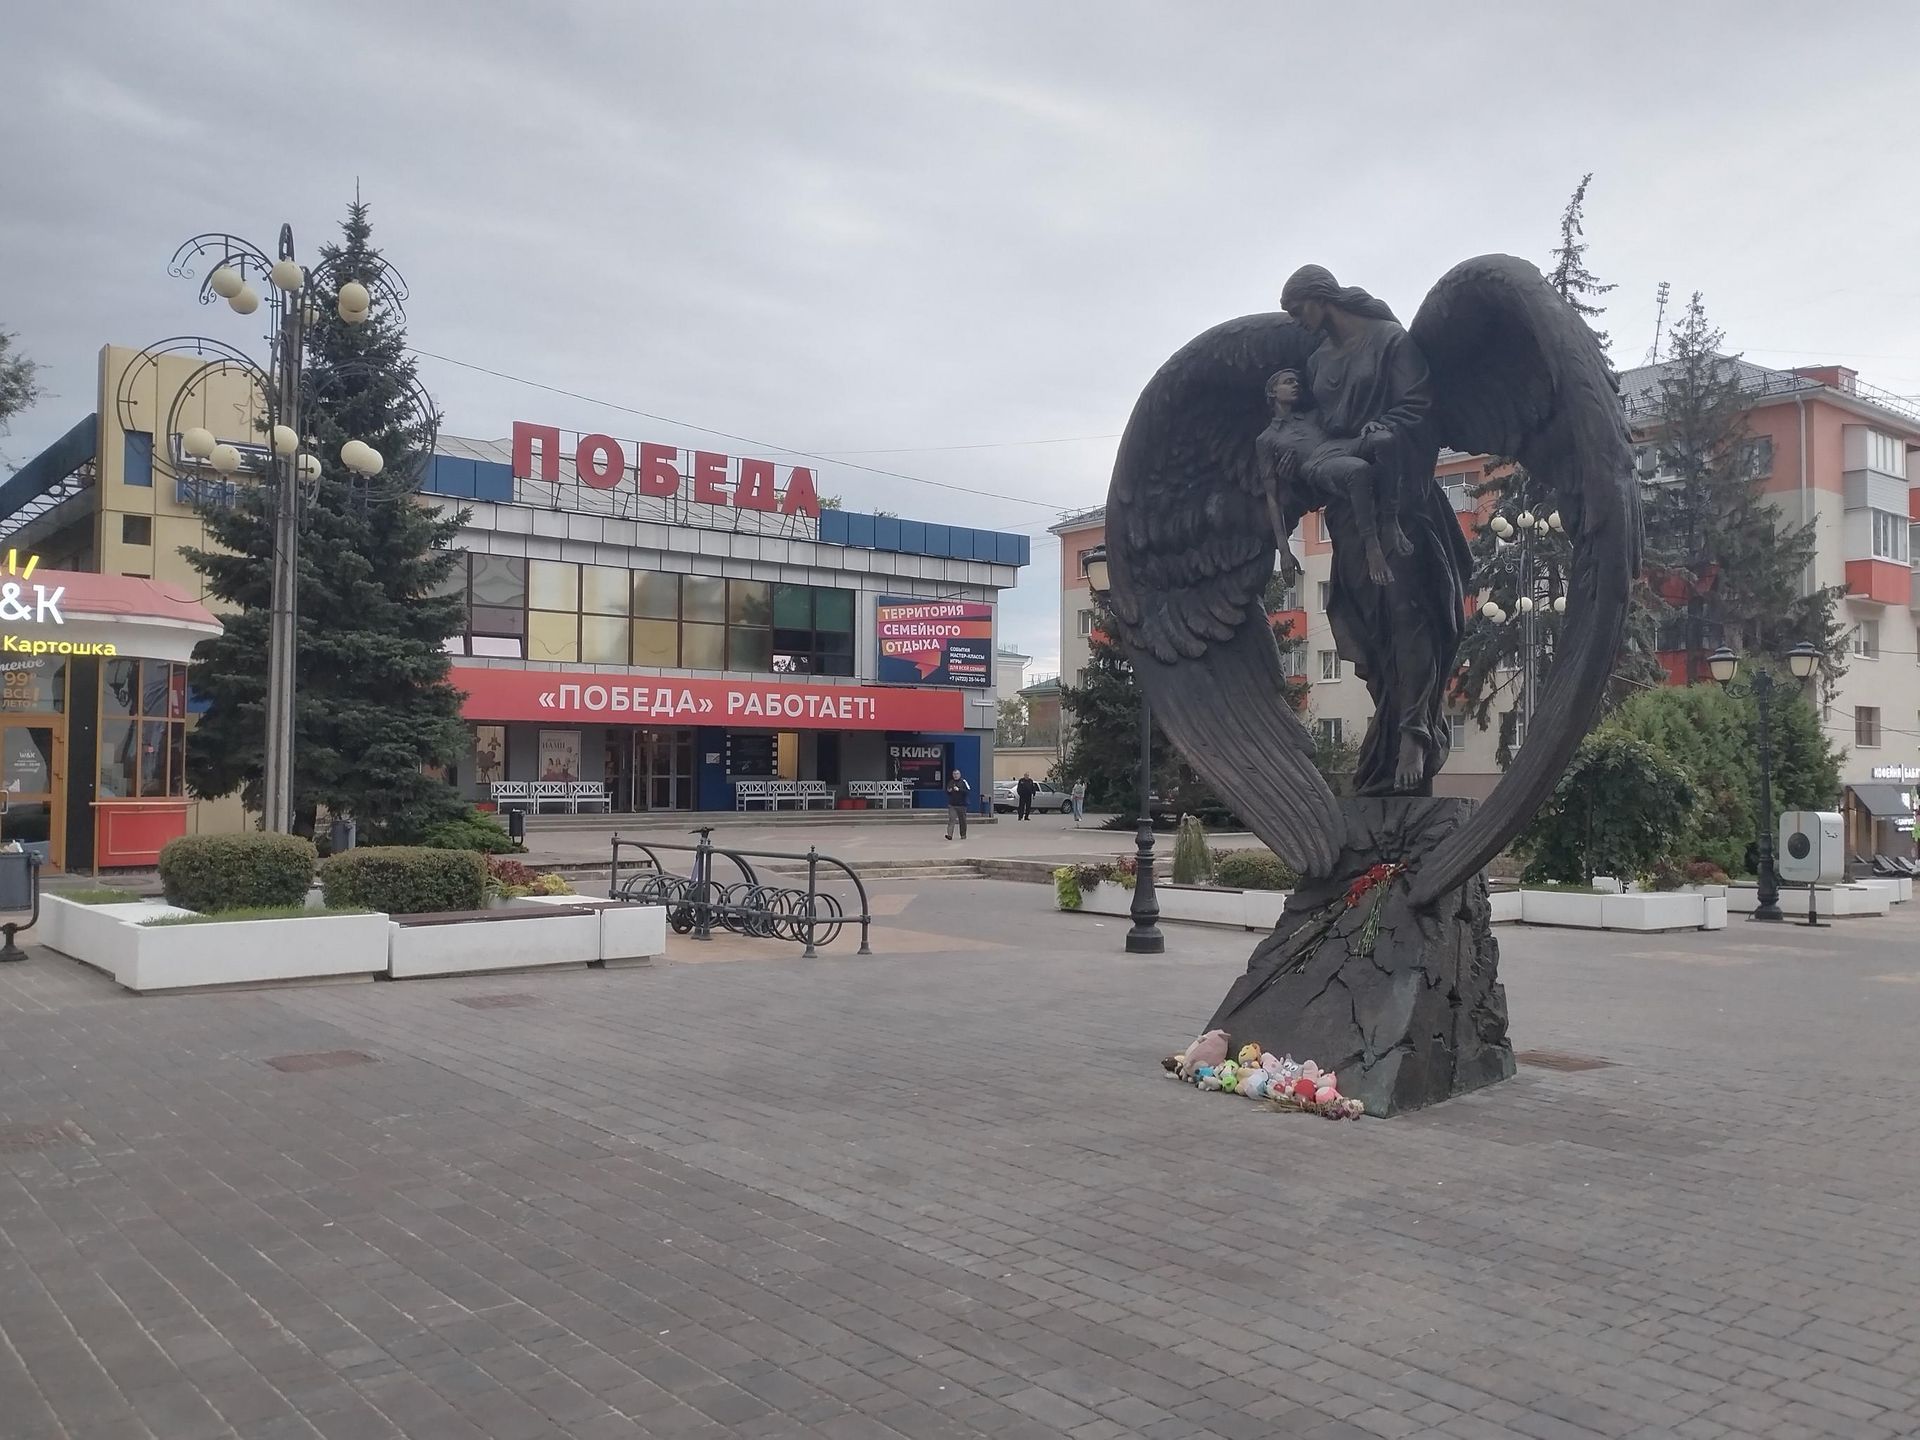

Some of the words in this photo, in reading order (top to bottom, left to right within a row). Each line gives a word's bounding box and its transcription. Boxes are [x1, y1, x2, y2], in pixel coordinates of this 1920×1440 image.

[513, 421, 821, 518] ПОБЕДА
[882, 605, 964, 620] ТЕРРИТОРИЯ
[883, 622, 961, 636] СЕМЕЙНОГО
[4, 635, 117, 656] Картошка
[885, 639, 940, 653] ОТДЫХА
[949, 652, 985, 660] МАСТЕР-КЛАССЫ
[538, 684, 713, 717] «ПОБЕДА»
[727, 691, 875, 720] РАБОТАЕТ!
[890, 746, 900, 757] В
[902, 746, 941, 758] КИНО
[1874, 765, 1902, 778] КОФЕЙНЯ
